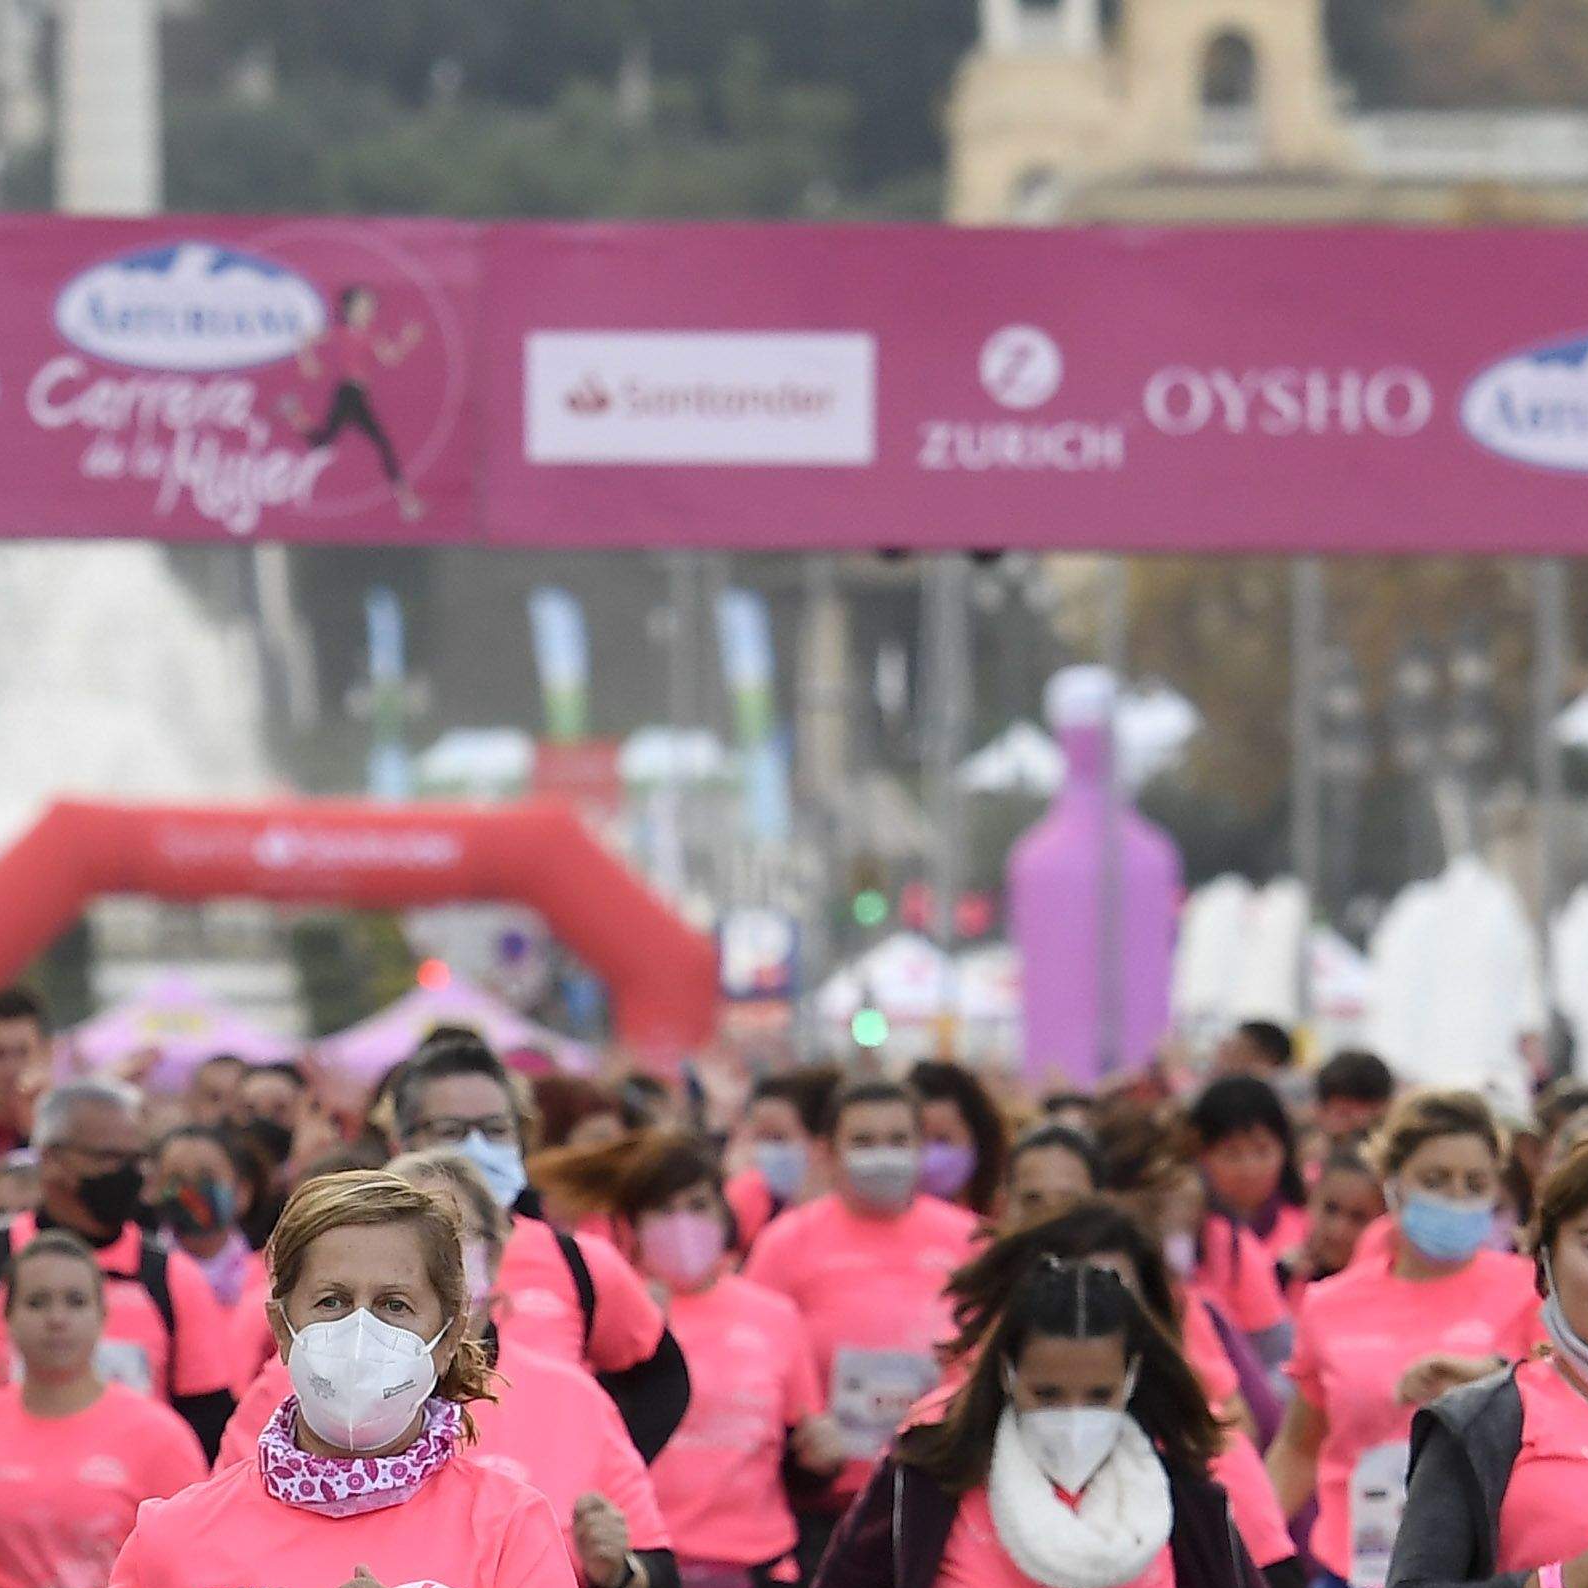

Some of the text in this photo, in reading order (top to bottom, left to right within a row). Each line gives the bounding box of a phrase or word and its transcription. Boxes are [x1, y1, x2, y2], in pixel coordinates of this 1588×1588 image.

[25, 357, 256, 432] Carrera
[1143, 364, 1433, 437] OYSHO
[155, 425, 332, 534] Mujer
[918, 423, 1125, 471] ZURICH
